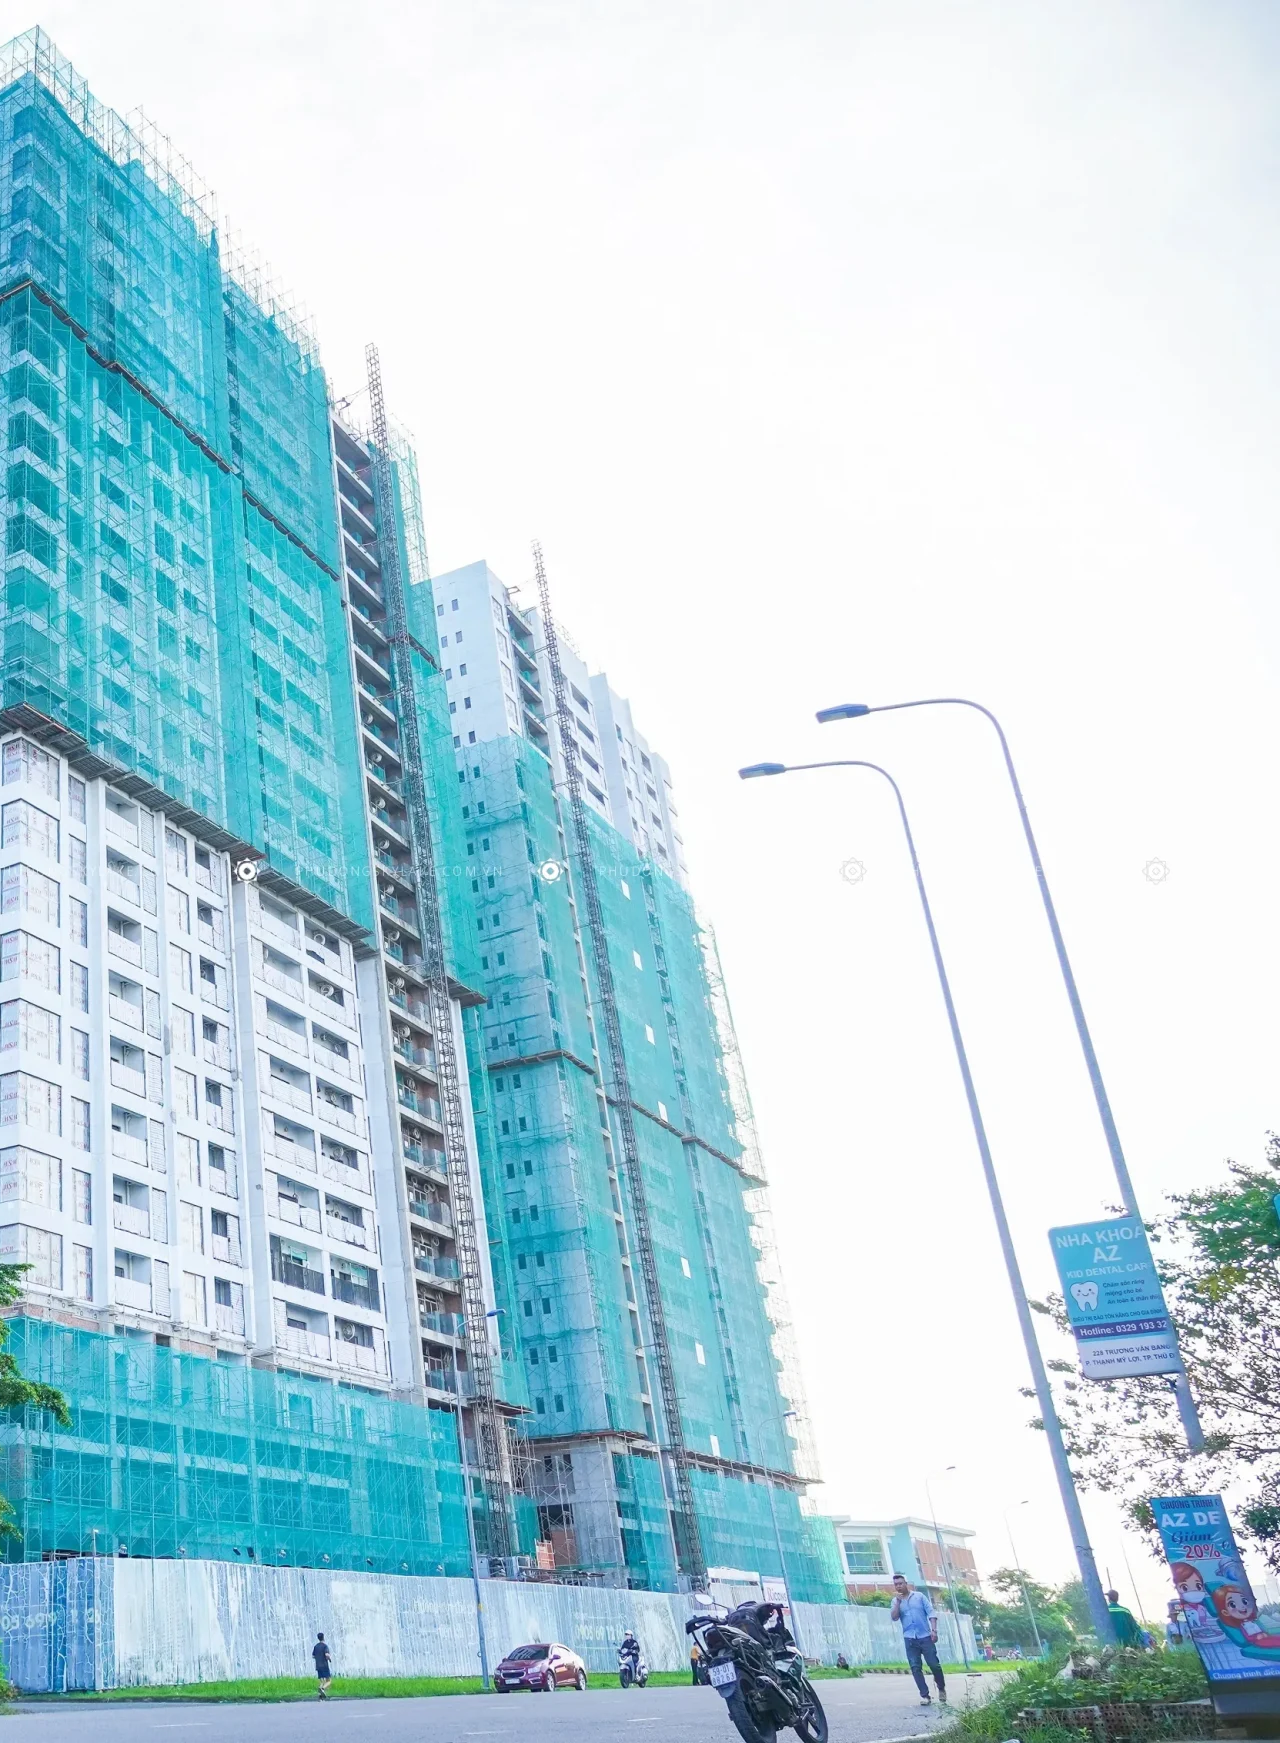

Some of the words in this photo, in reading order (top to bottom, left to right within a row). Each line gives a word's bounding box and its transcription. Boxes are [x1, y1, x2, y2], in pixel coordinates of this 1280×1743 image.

[1055, 1233, 1093, 1248] NHA
[1095, 1226, 1142, 1243] KHOA
[1093, 1245, 1122, 1263] AZ
[1066, 1270, 1084, 1279] KID
[1086, 1265, 1125, 1277] DENTAL
[1080, 1326, 1115, 1336] Hotline:
[1115, 1323, 1137, 1333] 0329
[1138, 1321, 1155, 1330] 193
[1092, 1349, 1104, 1357] 228
[1160, 1500, 1191, 1510] CHƯƠNG
[1190, 1498, 1213, 1508] TRÌNH
[1161, 1512, 1189, 1527] AZ
[1193, 1510, 1221, 1526] DE
[1171, 1530, 1212, 1545] Giảm
[1183, 1544, 1221, 1559] 20%
